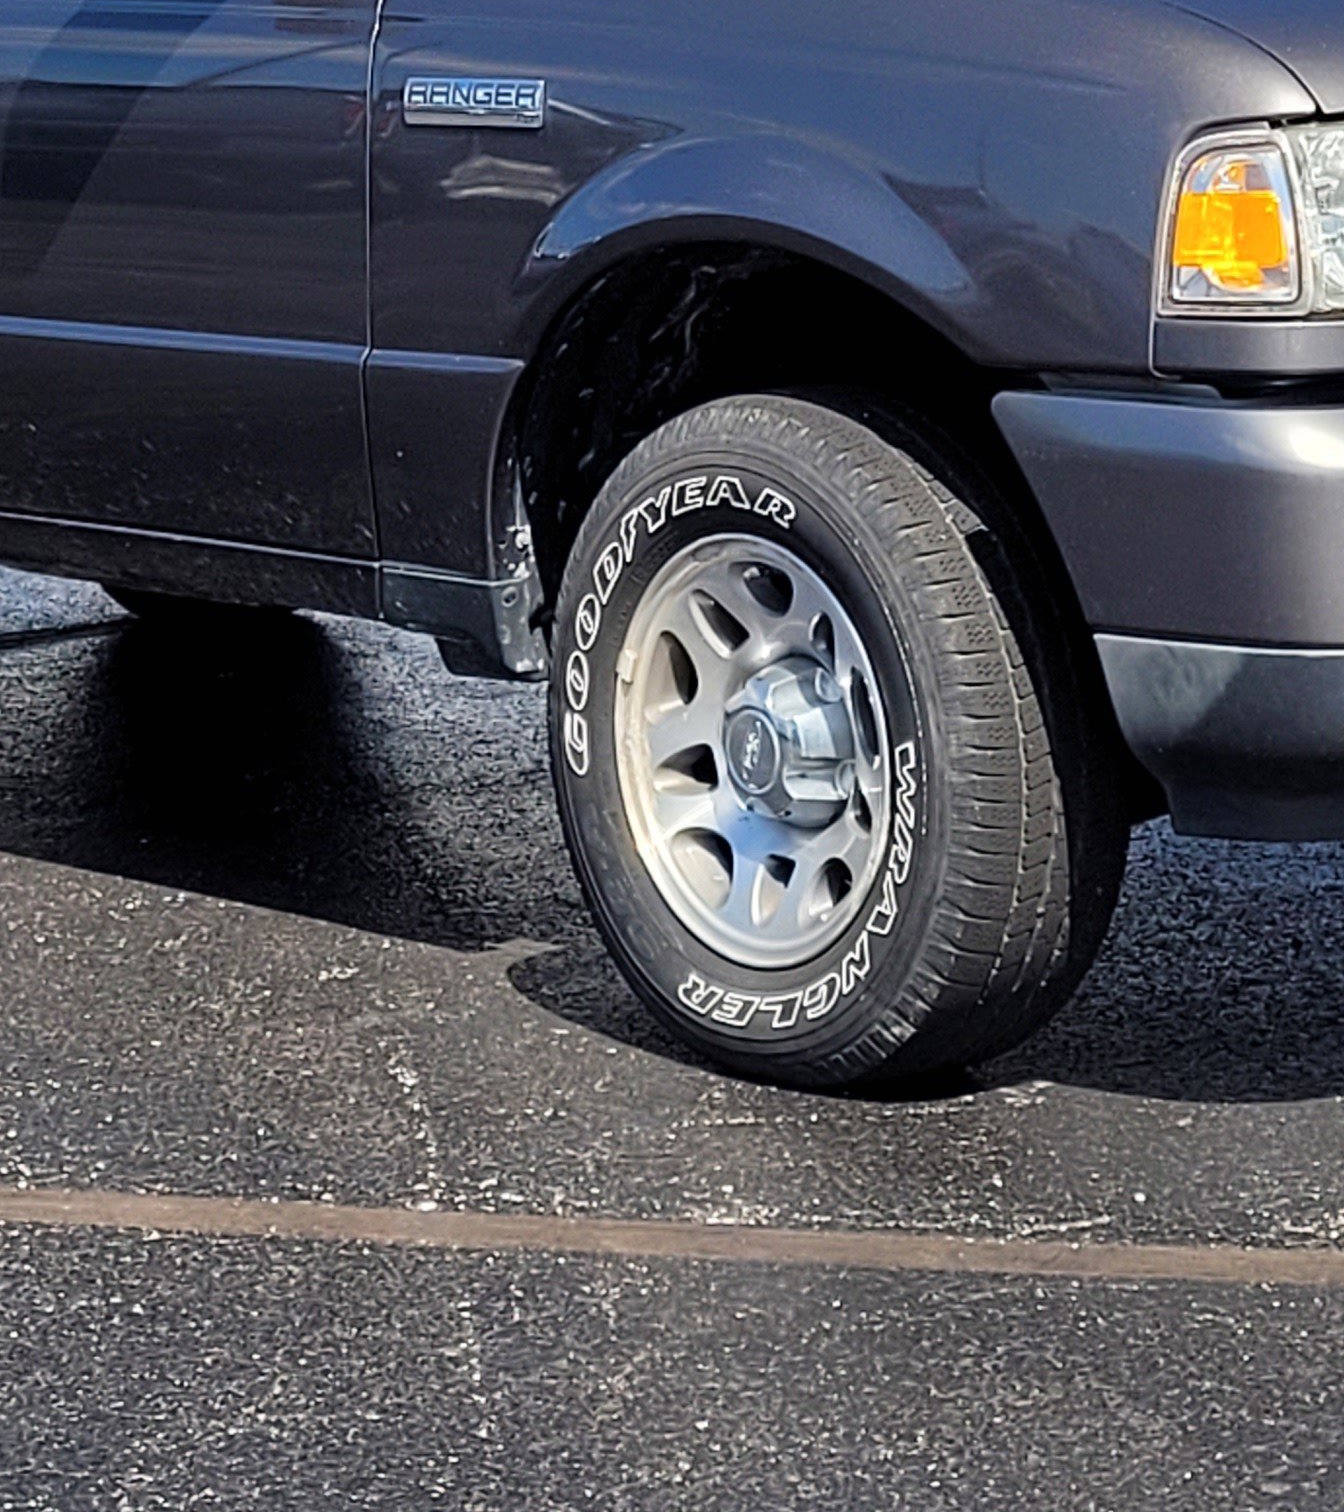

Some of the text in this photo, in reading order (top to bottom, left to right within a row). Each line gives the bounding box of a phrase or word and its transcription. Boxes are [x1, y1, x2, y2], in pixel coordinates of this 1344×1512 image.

[408, 81, 541, 108] RANGER
[563, 475, 797, 777] GOODYEAR
[677, 741, 918, 1029] WRANGLER
